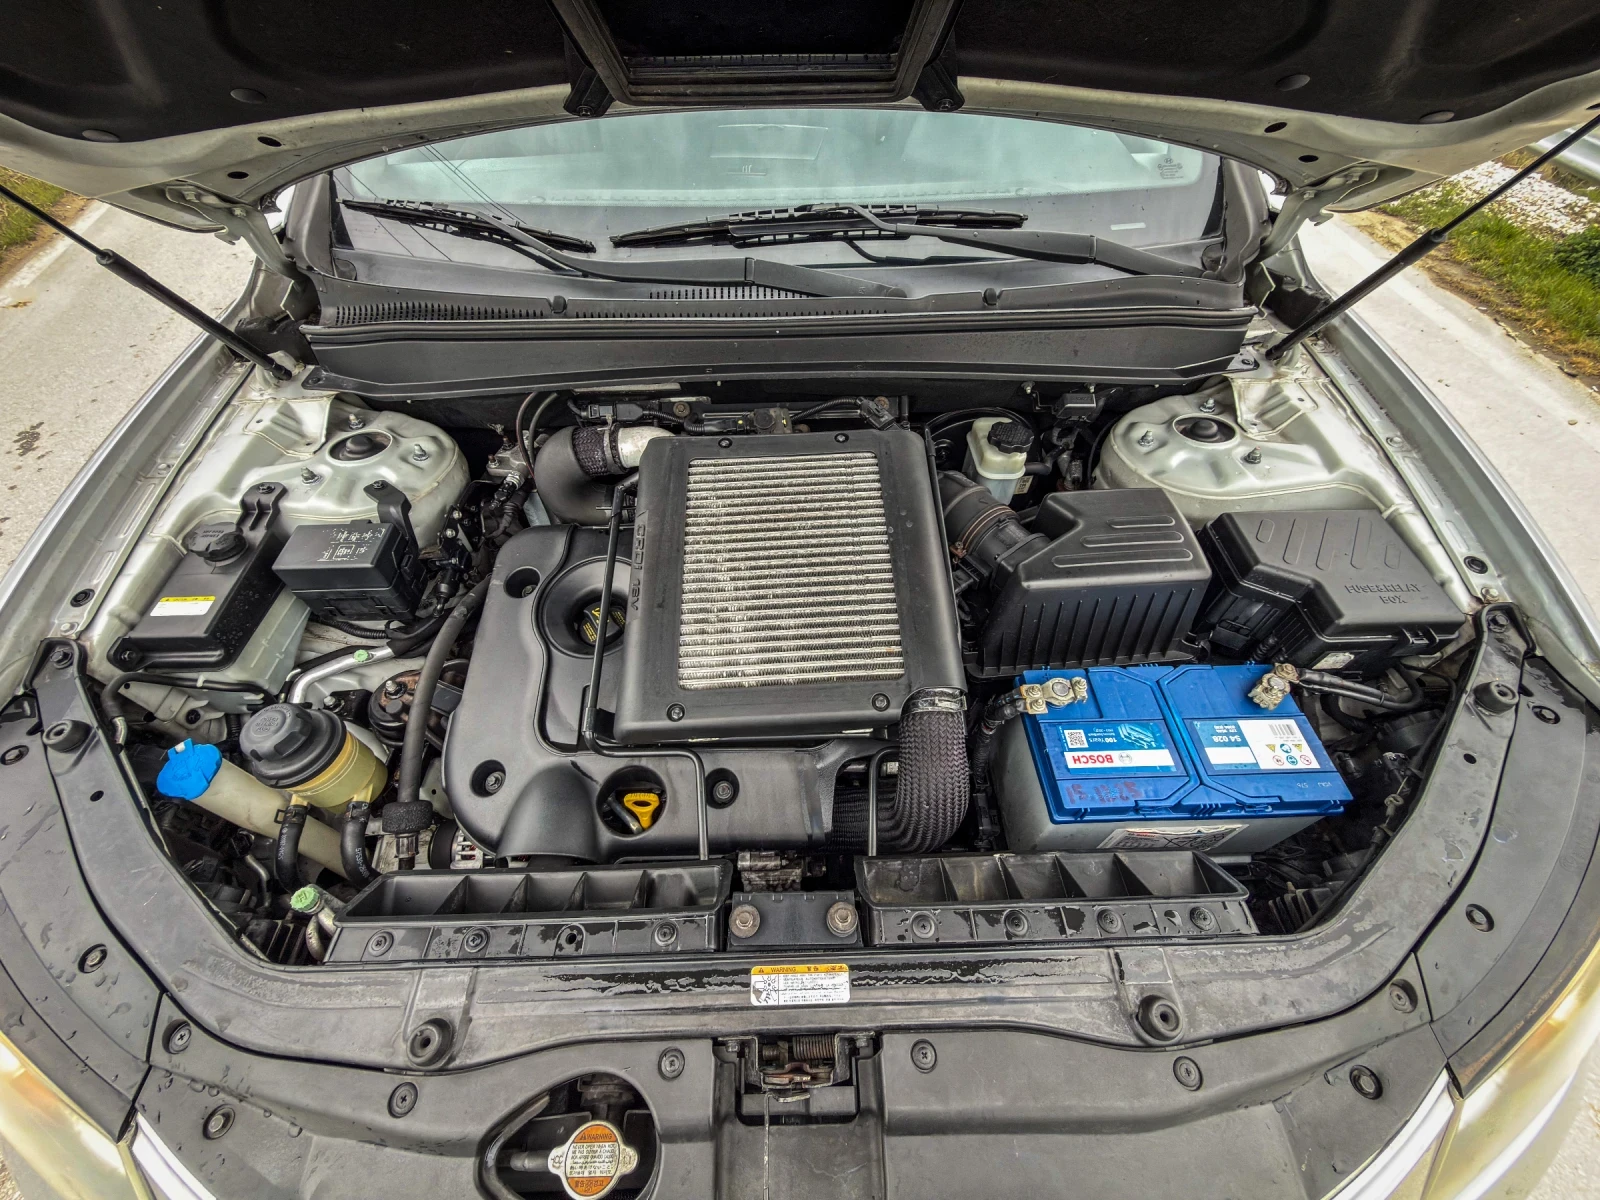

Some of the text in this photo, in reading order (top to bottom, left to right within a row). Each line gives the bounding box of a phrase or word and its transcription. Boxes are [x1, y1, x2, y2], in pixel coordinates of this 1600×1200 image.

[1344, 583, 1421, 594] FUSE&RELAY
[1379, 595, 1407, 605] BOX
[1072, 753, 1114, 765] BOSCH
